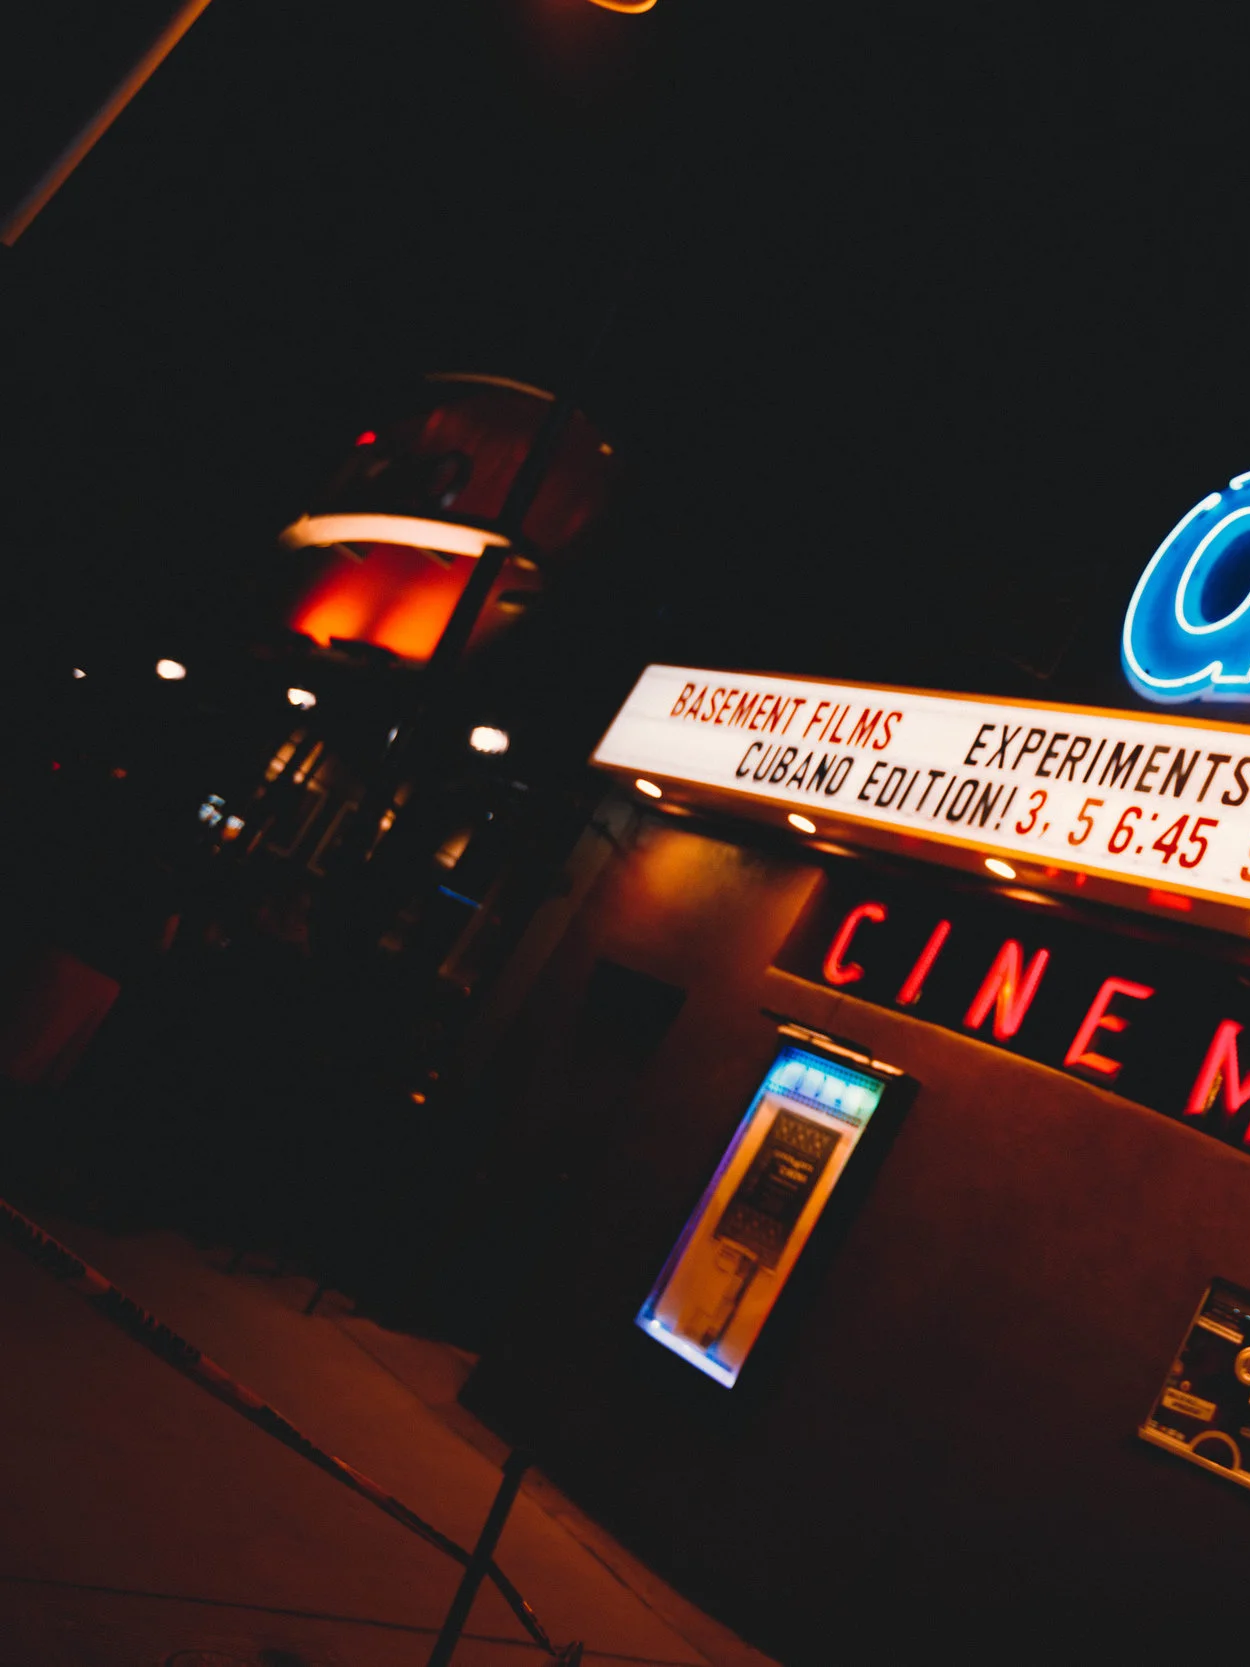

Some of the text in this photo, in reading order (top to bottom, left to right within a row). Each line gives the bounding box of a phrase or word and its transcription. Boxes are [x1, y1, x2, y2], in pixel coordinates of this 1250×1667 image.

[670, 682, 807, 735] BASEMENT
[806, 700, 903, 752] FILMS
[735, 741, 854, 797] CUBANO
[856, 761, 1019, 831] EDITION!
[1067, 798, 1105, 846] 5
[1107, 806, 1220, 869] 6:45
